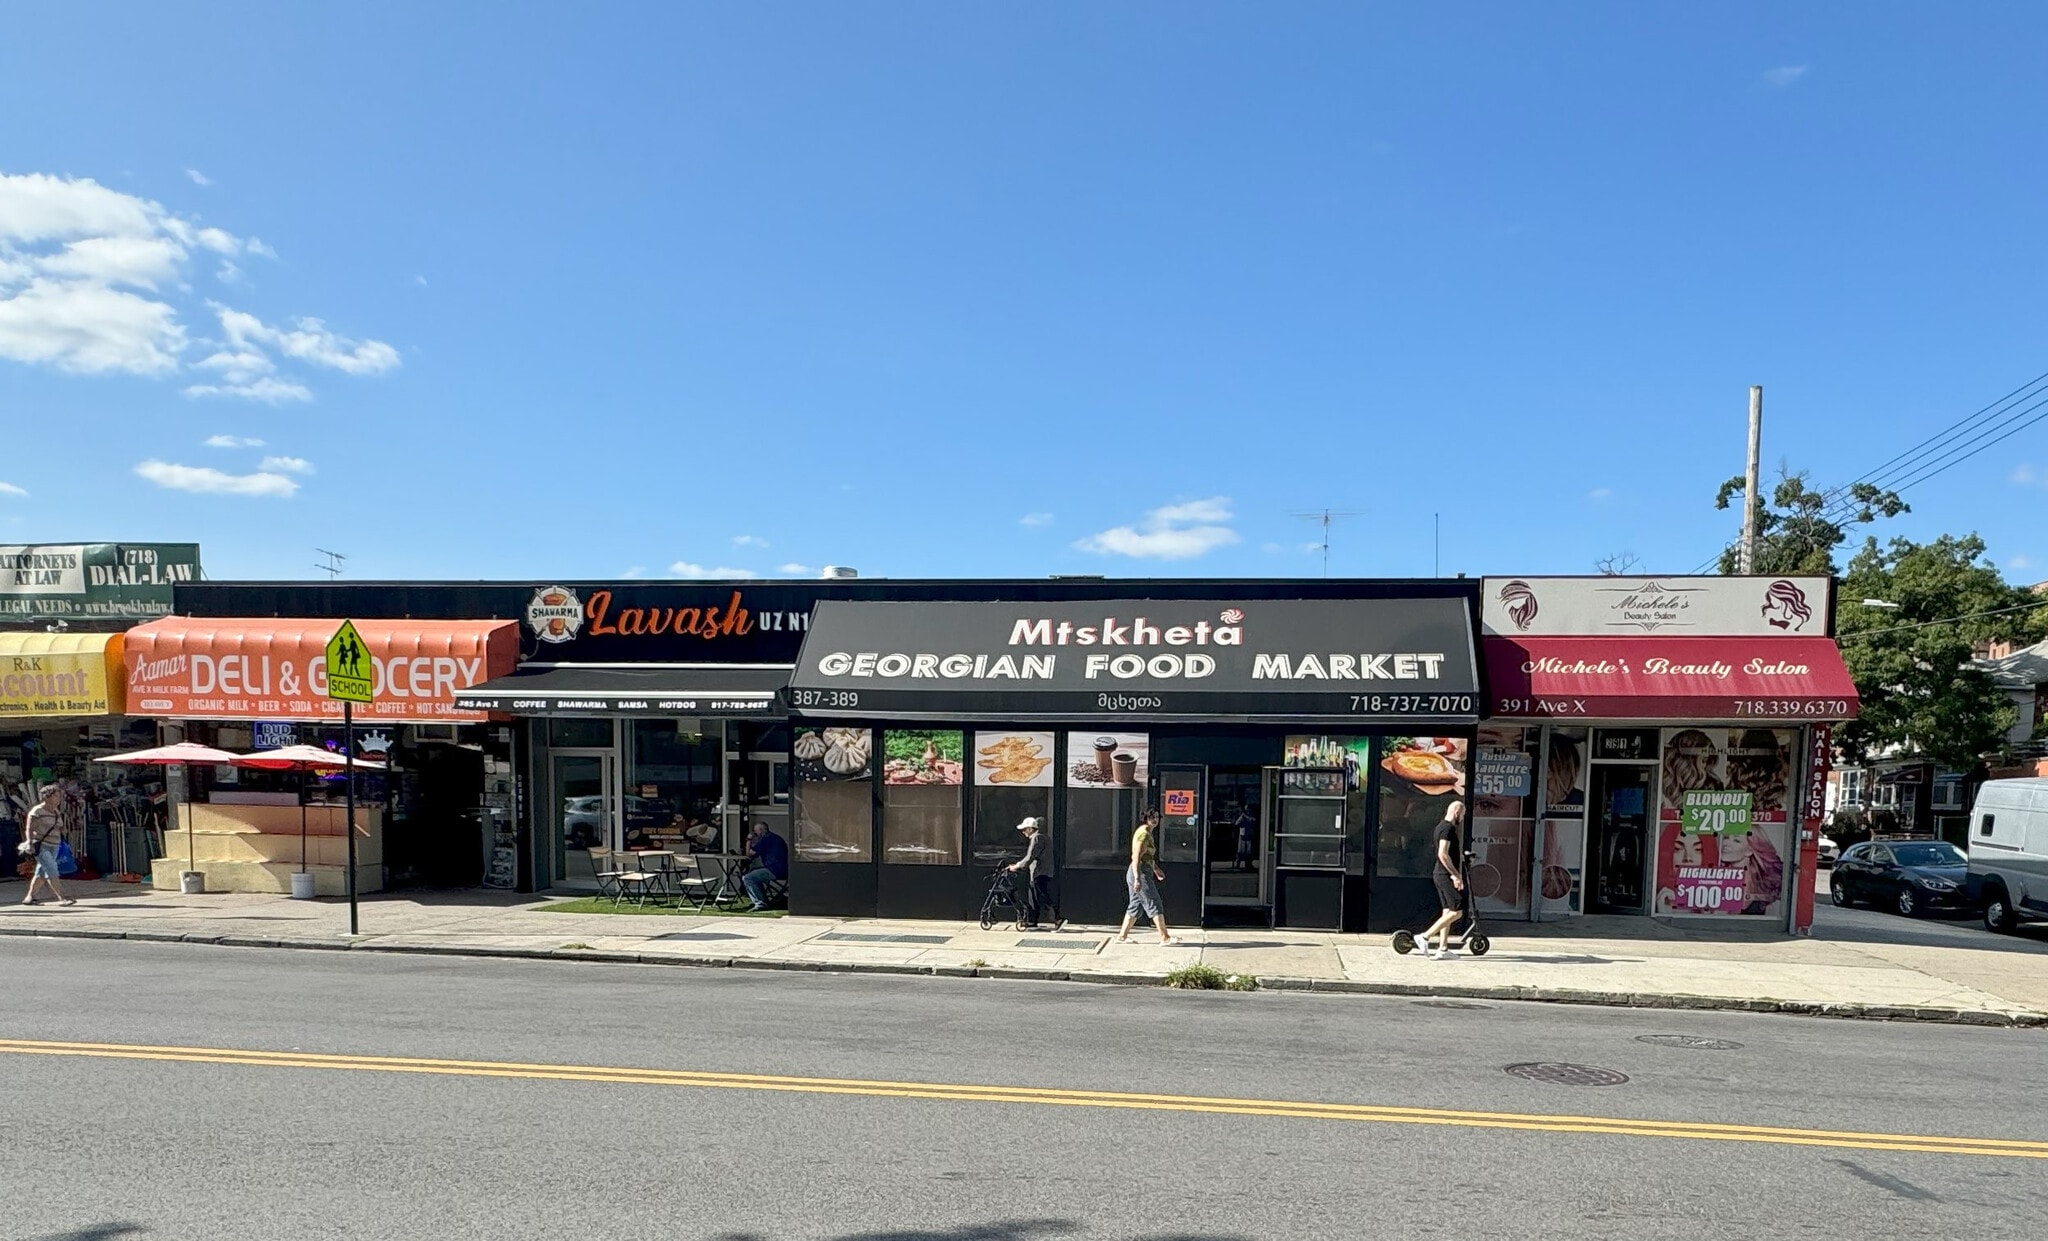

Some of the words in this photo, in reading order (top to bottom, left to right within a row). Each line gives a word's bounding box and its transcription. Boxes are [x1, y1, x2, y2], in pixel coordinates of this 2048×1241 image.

[0, 554, 76, 569] ATTORNEYS
[124, 549, 158, 566] (718)
[14, 571, 32, 585] AT
[35, 571, 62, 585] LAW
[89, 564, 194, 586] DIAL-LAW
[0, 600, 33, 613] LEGAL
[36, 600, 72, 614] NEEDS
[532, 608, 579, 619] SHAWARMA
[586, 590, 754, 639] Lavash
[759, 612, 782, 631] UZ
[1624, 611, 1652, 620] Beauty
[1654, 611, 1676, 620] Salon
[13, 657, 42, 671] R&K
[818, 653, 1056, 680] GEORGIAN
[1085, 653, 1217, 680] FOOD
[1252, 653, 1445, 680] MARKET
[1521, 657, 1630, 674] Michele's
[1642, 658, 1732, 679] Beauty
[1743, 658, 1810, 675] Salon
[130, 652, 188, 684] Aamar
[191, 654, 271, 695] DELI
[279, 661, 301, 696] &
[308, 656, 482, 698] GOCERY
[132, 685, 146, 694] AVE
[152, 686, 169, 694] MILK
[170, 686, 189, 694] FARM
[331, 679, 371, 697] SCHOOL
[34, 700, 58, 710] Health
[67, 700, 92, 711] Beauty
[659, 701, 696, 709] HOTDOG
[793, 690, 859, 707] 387-389
[1098, 692, 1162, 710] მცხეთა
[1350, 696, 1472, 711] 718-737-7070
[1500, 699, 1530, 712] 391
[1535, 700, 1568, 713] Ave
[1573, 700, 1586, 713] X
[188, 699, 225, 711] ORGANIC
[228, 699, 249, 711] MILK
[259, 700, 280, 712] BEER
[290, 701, 312, 712] SODA
[322, 701, 367, 713] CIGATTE
[376, 702, 407, 714] COFFEE
[417, 703, 432, 714] HOT
[1734, 701, 1848, 715] 718.339.6370
[262, 723, 291, 735] BUD
[257, 734, 298, 746] LIGHT
[1814, 730, 1825, 766] HAIR
[1481, 752, 1516, 761] Russian
[1475, 773, 1522, 794] $55.00
[1168, 791, 1189, 804] Ria
[1686, 793, 1749, 806] BLOWOUT
[1809, 772, 1822, 817] SALON
[1691, 808, 1746, 832] $20.00
[1679, 867, 1744, 880] HIGHLIGHTS
[1677, 884, 1743, 909] $100.00
